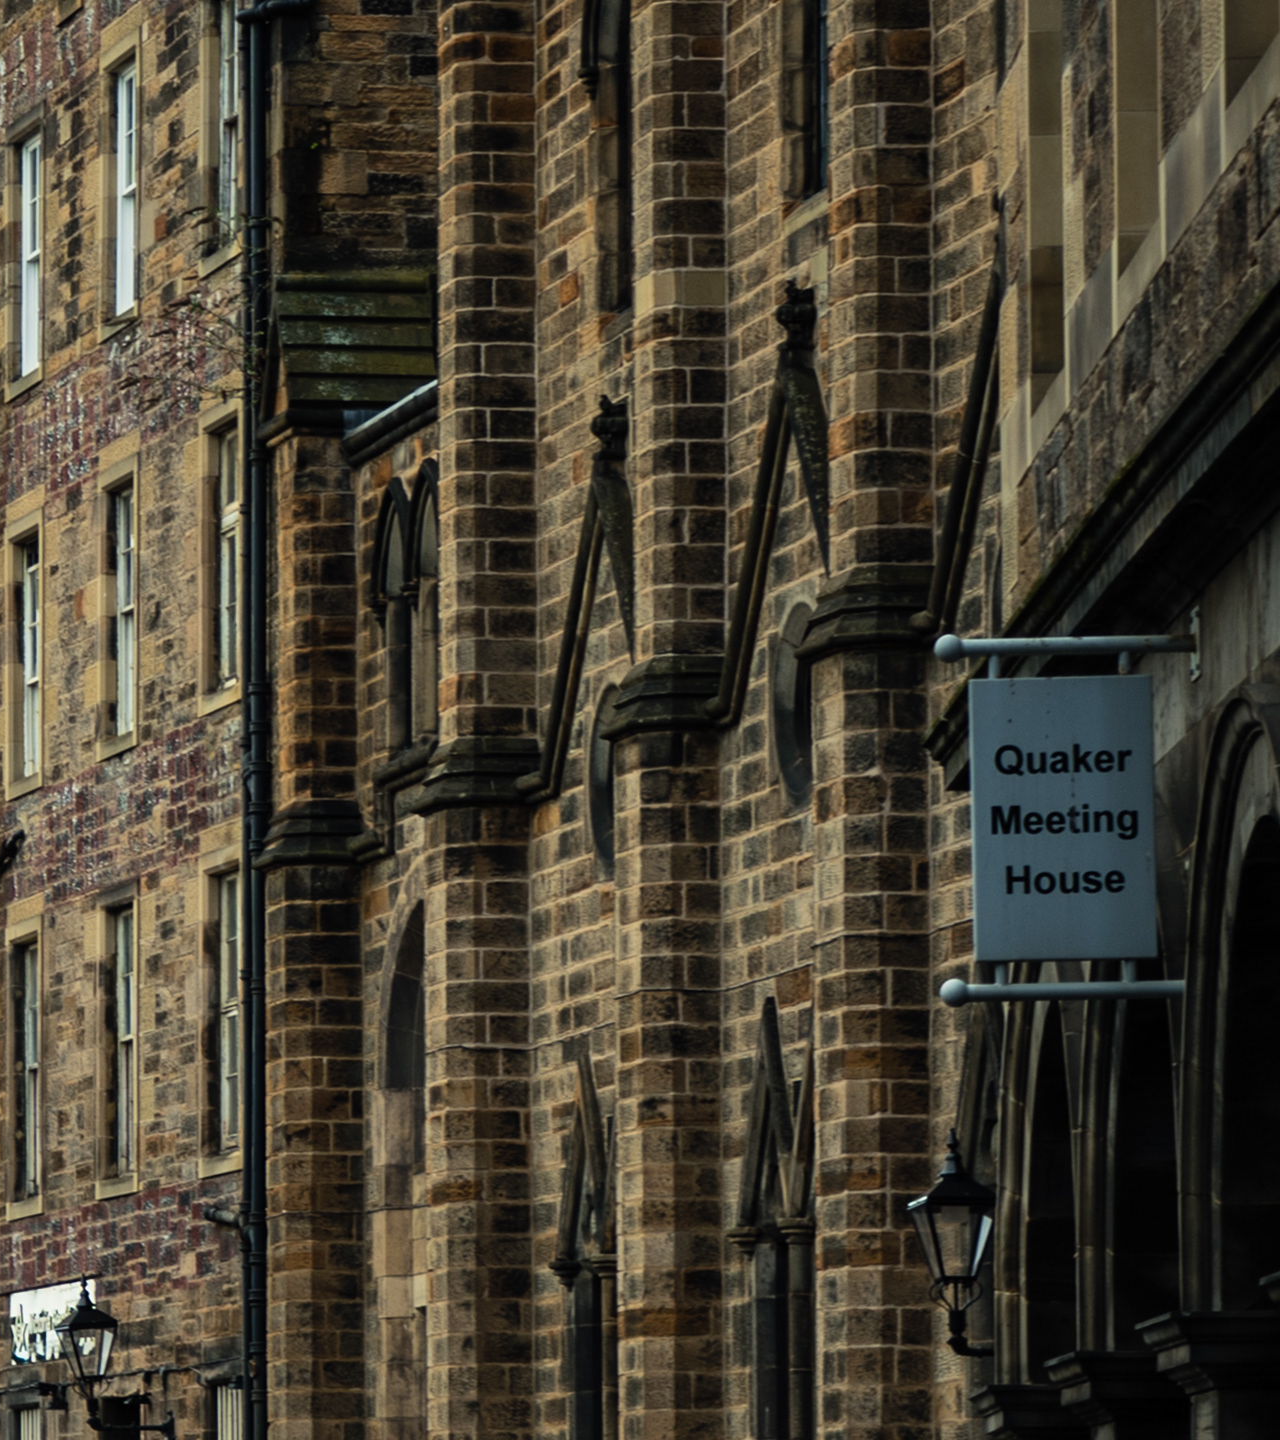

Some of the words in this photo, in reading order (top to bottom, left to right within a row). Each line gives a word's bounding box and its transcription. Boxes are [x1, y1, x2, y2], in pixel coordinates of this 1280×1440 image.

[994, 744, 1132, 776] Quaker
[991, 804, 1139, 840] Meeting
[1005, 865, 1126, 895] House
